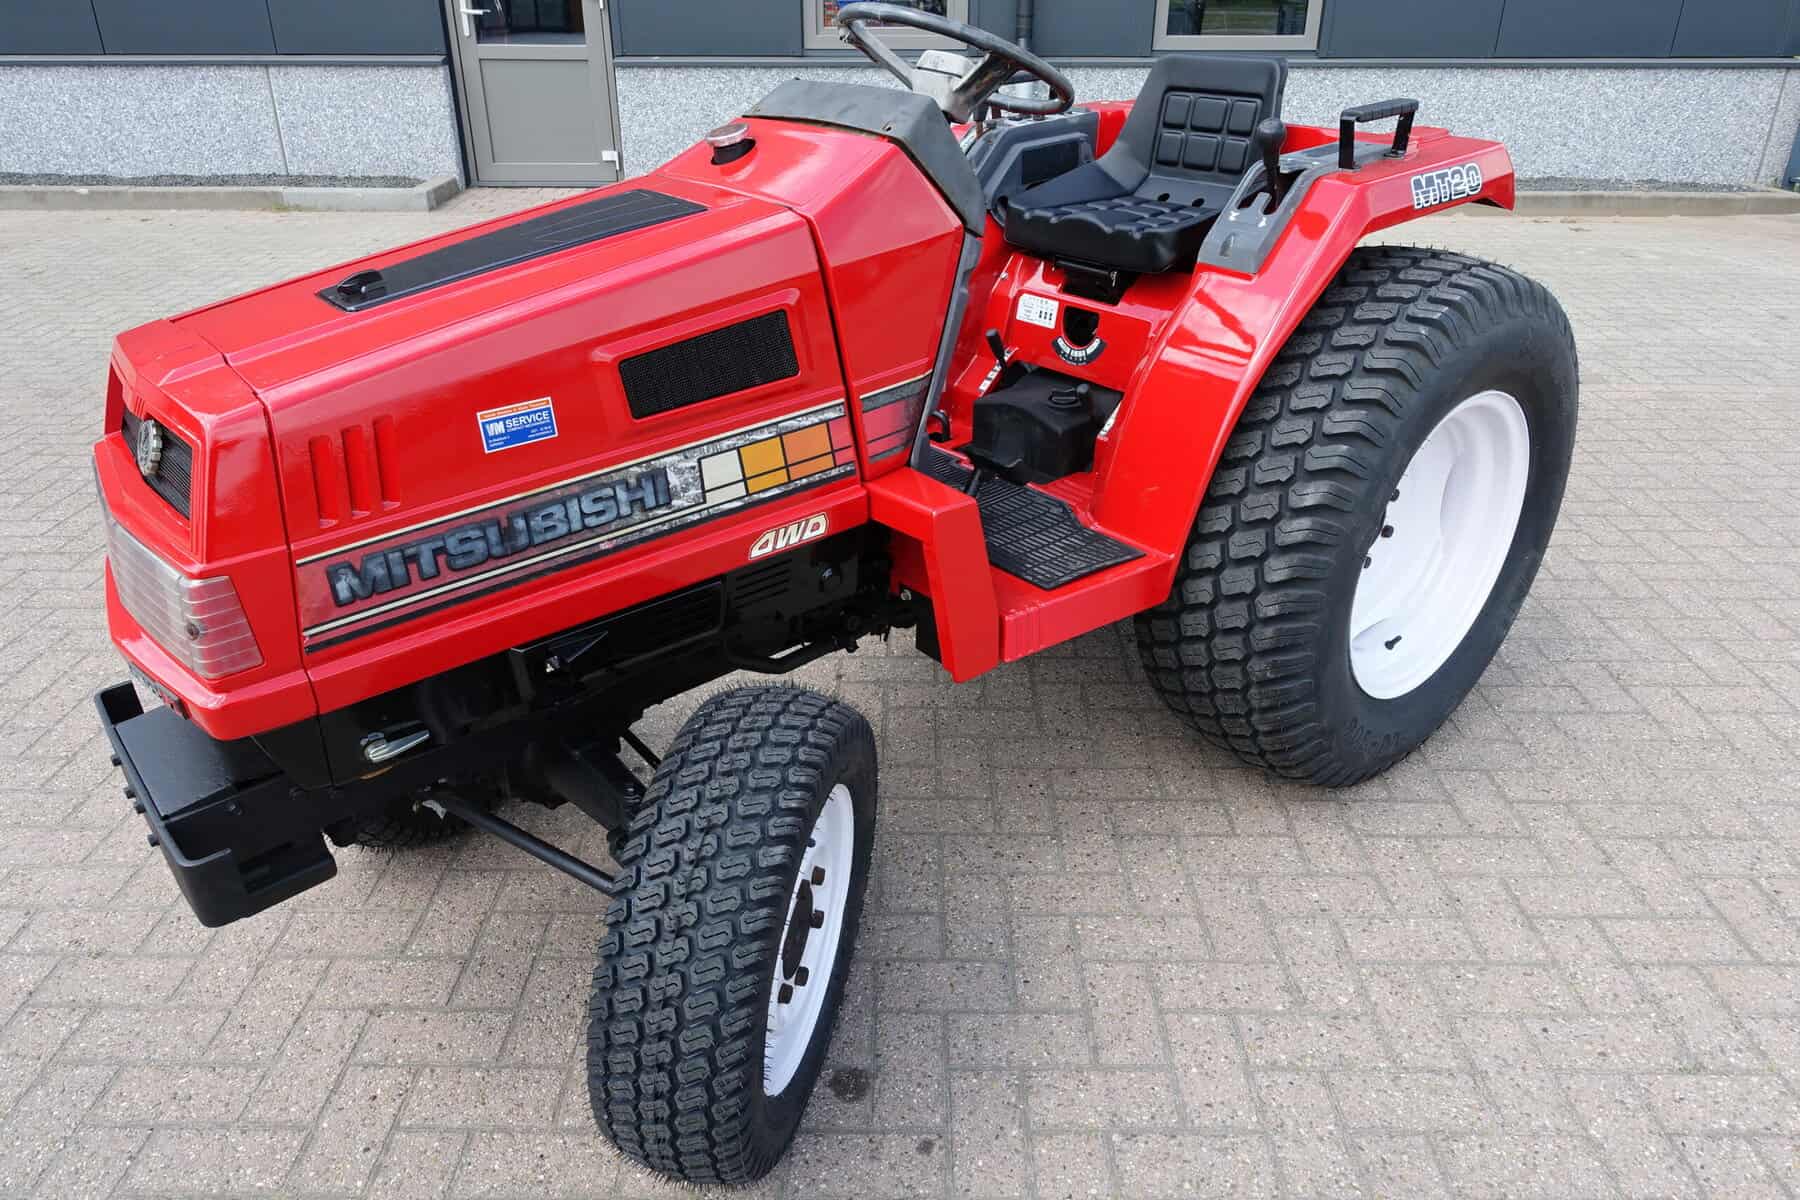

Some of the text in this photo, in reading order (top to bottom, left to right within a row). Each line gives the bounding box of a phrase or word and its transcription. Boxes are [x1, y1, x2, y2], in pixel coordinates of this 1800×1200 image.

[1411, 162, 1482, 209] MT20
[505, 410, 550, 428] SERVICE
[326, 466, 672, 606] MITSUBISHI
